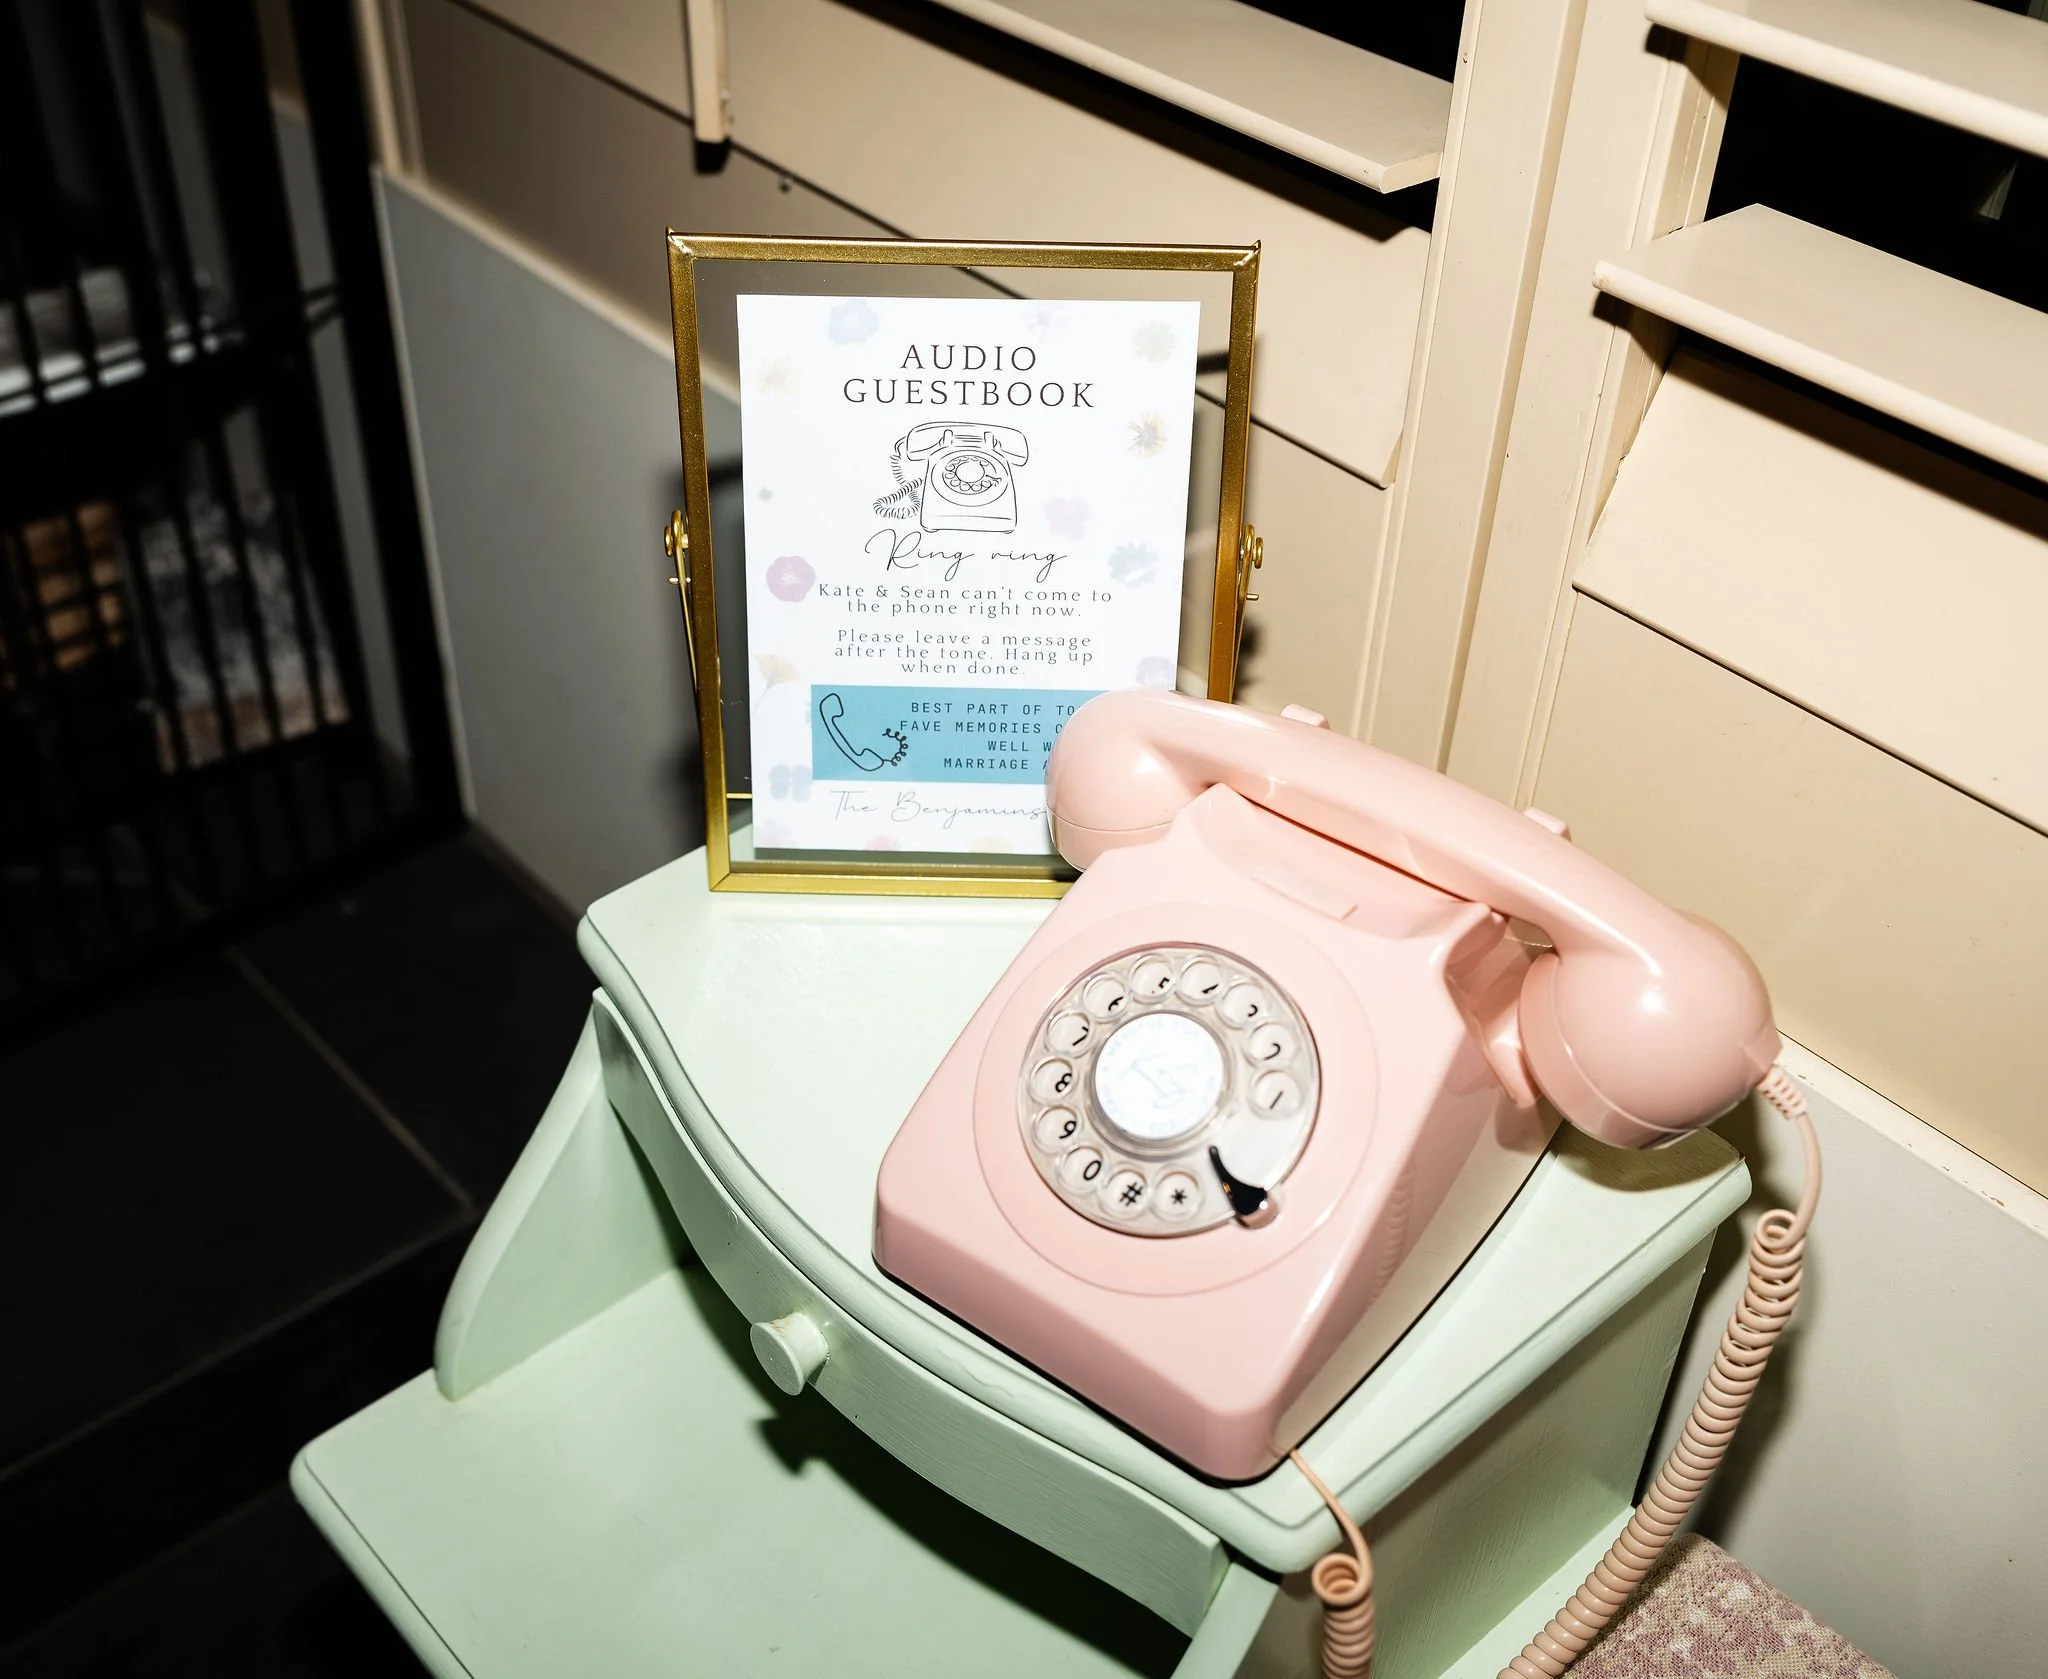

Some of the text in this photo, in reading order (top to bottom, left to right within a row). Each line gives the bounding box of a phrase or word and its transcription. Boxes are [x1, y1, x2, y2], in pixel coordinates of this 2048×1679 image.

[900, 344, 1037, 372] AUDIO
[844, 378, 1095, 409] GUESTBOOK
[865, 528, 1068, 584] Ring ring
[818, 583, 1112, 603] Kate & Sean can't come to
[847, 598, 1082, 619] the phone right now.
[838, 628, 1091, 650] Please leave a message
[834, 643, 1093, 666] after the tone. Hang up
[901, 660, 1026, 676] when done.
[911, 701, 1082, 717] BEST PART OF TO
[900, 719, 942, 733] FAVE
[955, 721, 1041, 734] MEMORIES
[987, 741, 1030, 752] WELL
[943, 757, 1029, 770] MARRIAGE
[830, 790, 878, 821] The
[1054, 1072, 1072, 1094] 8
[1058, 1120, 1077, 1140] 9
